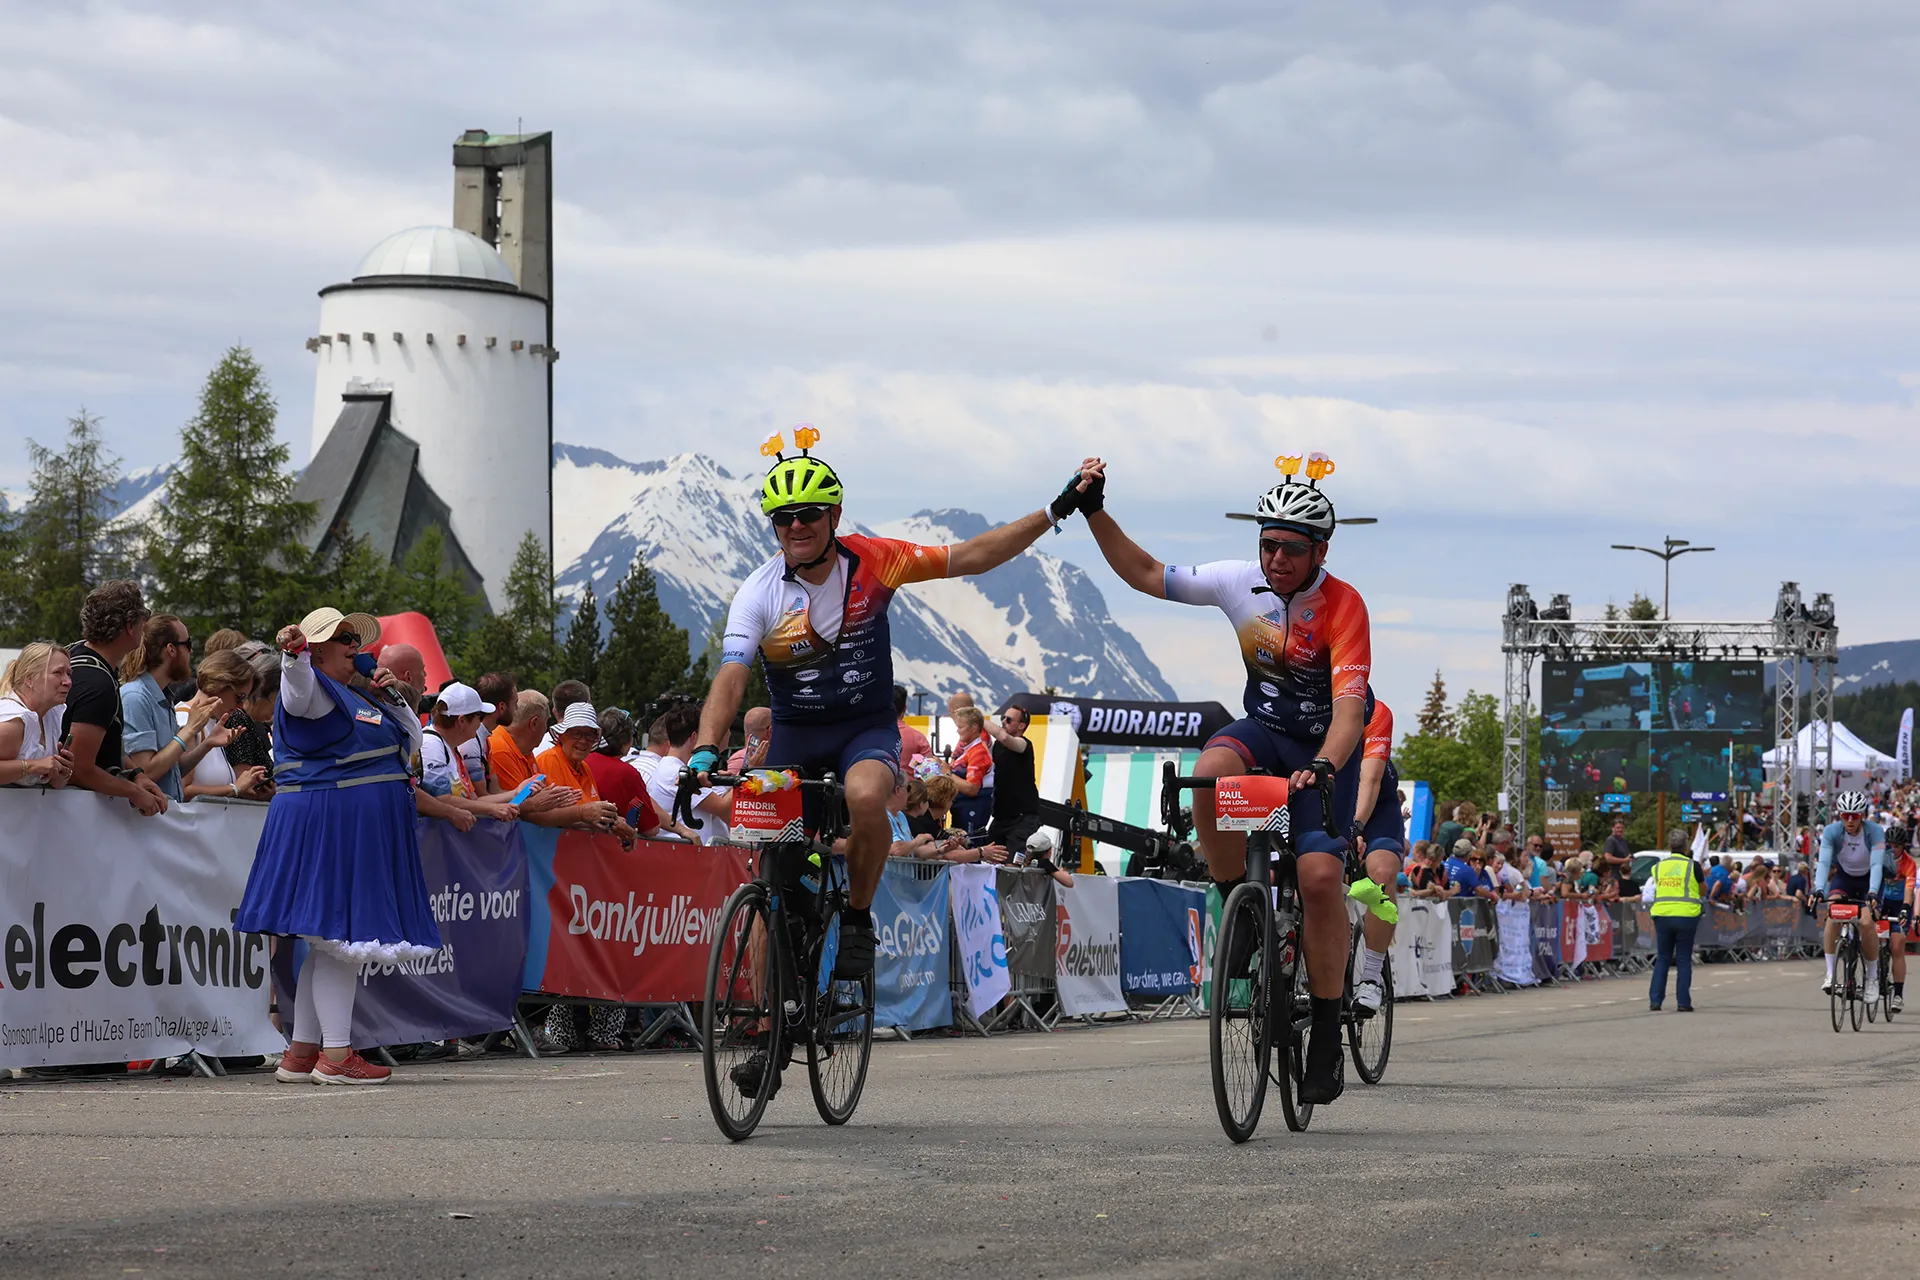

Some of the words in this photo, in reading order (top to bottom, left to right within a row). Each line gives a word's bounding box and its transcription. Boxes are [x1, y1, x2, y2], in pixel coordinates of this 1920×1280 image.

[789, 640, 811, 653] HAL
[1087, 707, 1202, 737] BIORACER
[735, 801, 776, 811] HENDRIK
[1219, 791, 1244, 799] PAUL
[430, 882, 474, 923] actie
[480, 889, 521, 920] voor
[568, 884, 729, 956] Dankjulliewe
[5, 902, 265, 991] electronic
[38, 1022, 65, 1049] Alpe
[70, 1020, 124, 1043] d'HuZes
[128, 1018, 152, 1040] Team
[154, 1016, 209, 1042] Challenge
[211, 1022, 219, 1036] 4
